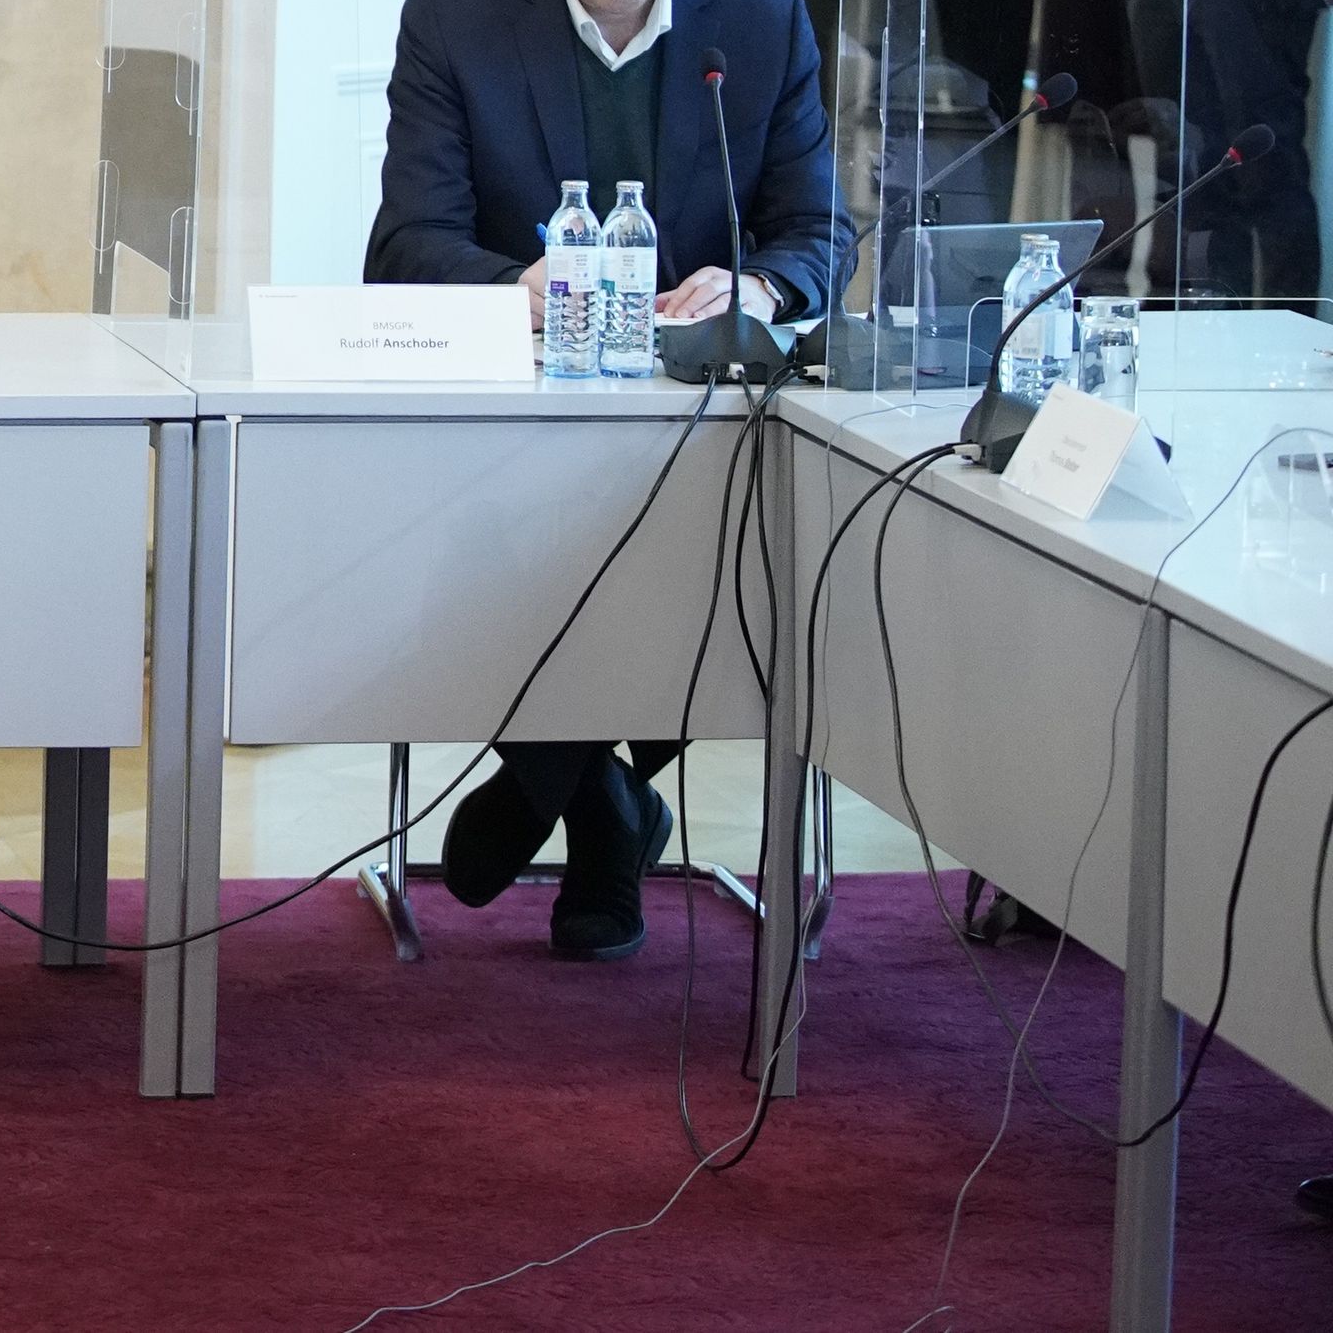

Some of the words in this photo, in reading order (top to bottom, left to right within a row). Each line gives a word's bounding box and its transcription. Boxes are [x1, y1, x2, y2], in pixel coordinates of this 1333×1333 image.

[372, 321, 414, 330] BMSGPK
[339, 337, 380, 348] Rudolf
[383, 337, 450, 348] Anschober
